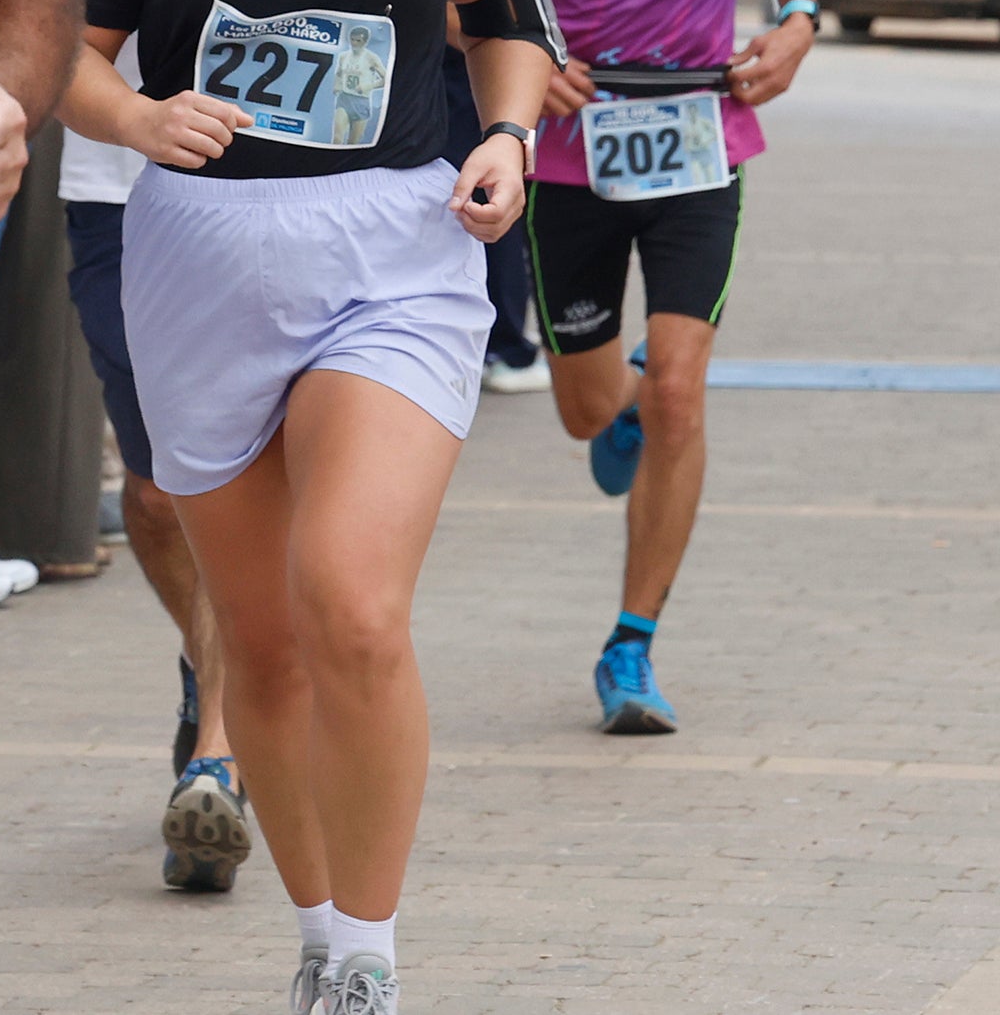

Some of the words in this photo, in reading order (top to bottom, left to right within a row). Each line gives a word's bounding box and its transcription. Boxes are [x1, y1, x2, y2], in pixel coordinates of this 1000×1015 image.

[290, 27, 331, 42] HARO
[205, 41, 334, 113] 227
[595, 129, 684, 178] 202
